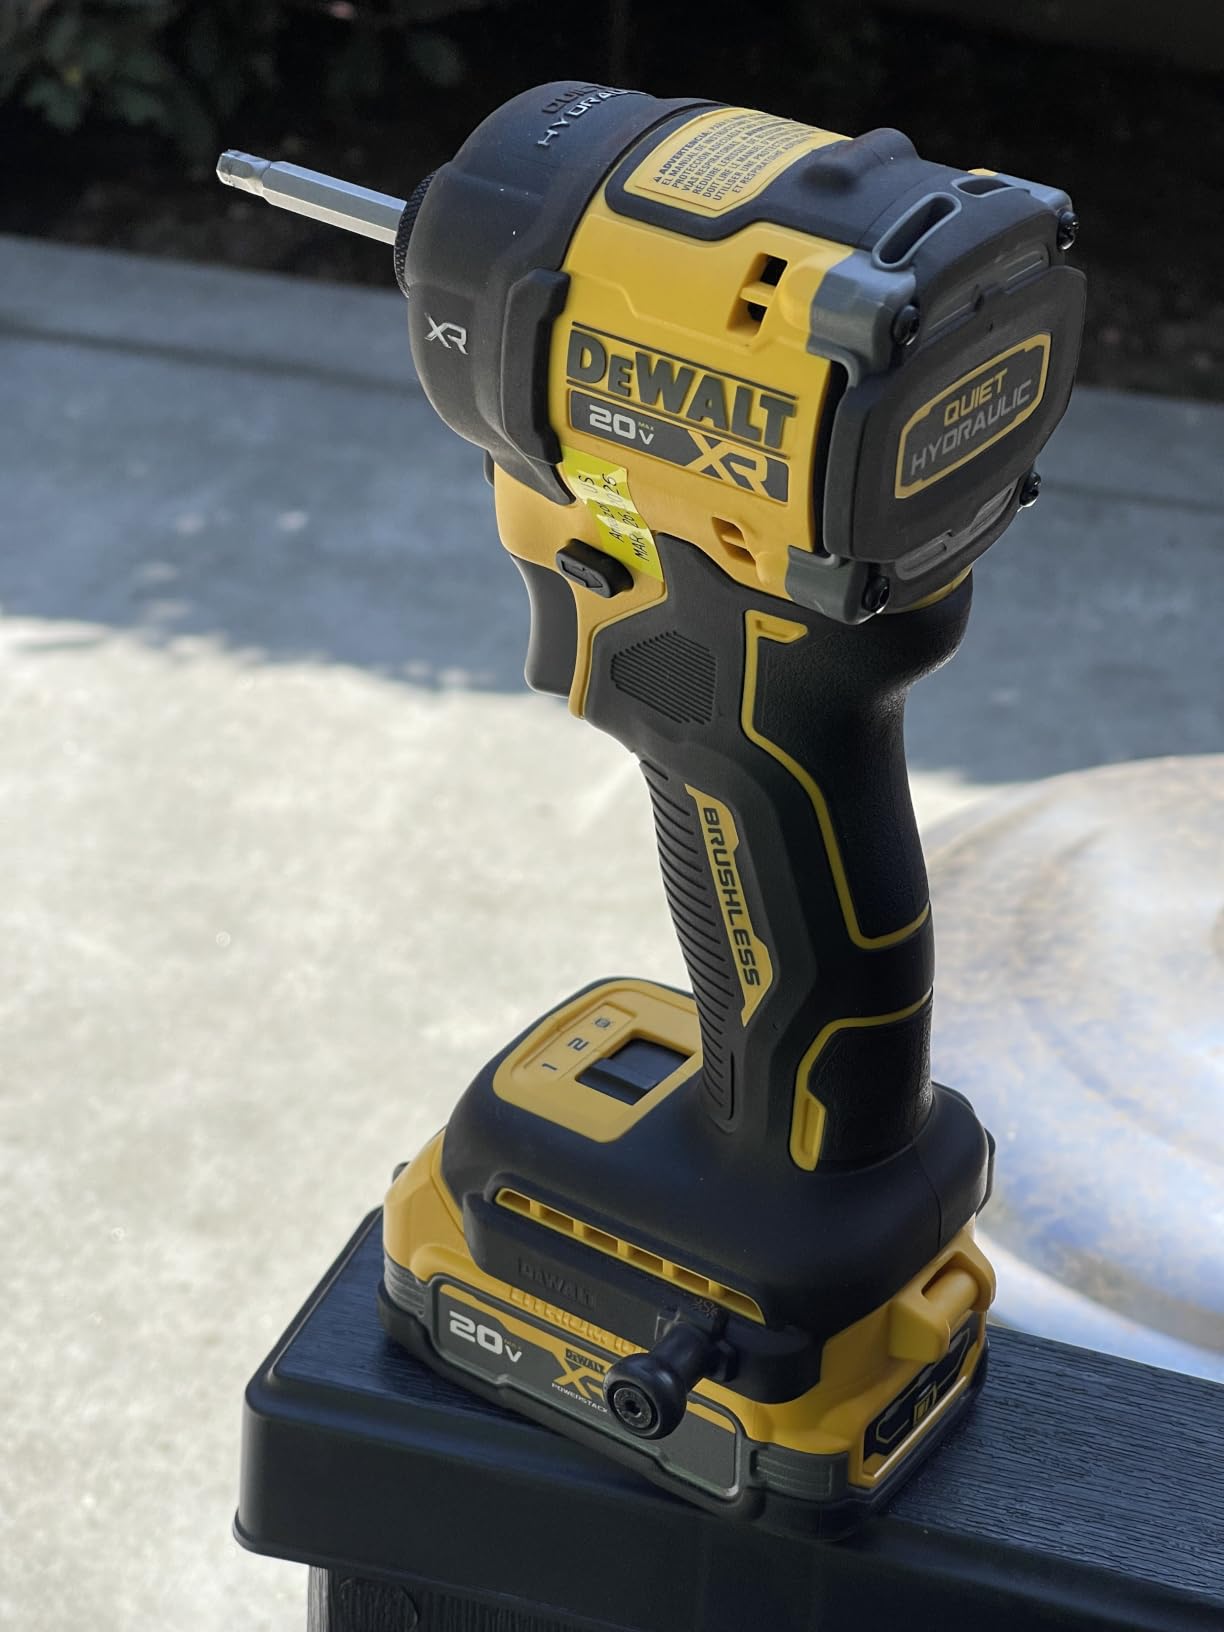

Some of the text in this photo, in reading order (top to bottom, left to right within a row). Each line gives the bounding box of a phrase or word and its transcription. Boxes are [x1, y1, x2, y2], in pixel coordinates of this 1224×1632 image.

[661, 177, 672, 185] EL
[669, 151, 697, 176] MANUAL
[701, 182, 720, 197] DOIT
[717, 169, 731, 181] LIRE
[711, 171, 744, 200] UTILISER
[740, 160, 755, 172] UNE
[753, 137, 794, 160] PROTECT
[732, 184, 743, 193] ET
[424, 312, 468, 355] XR
[566, 329, 796, 449] DEWALT
[943, 368, 1008, 427] QUIET
[911, 379, 1032, 475] HYDRAULIC
[687, 429, 771, 499] XR
[629, 531, 650, 562] MAR
[703, 807, 760, 987] BRUSHLESS
[567, 1037, 589, 1052] 2
[542, 1062, 558, 1071] 1
